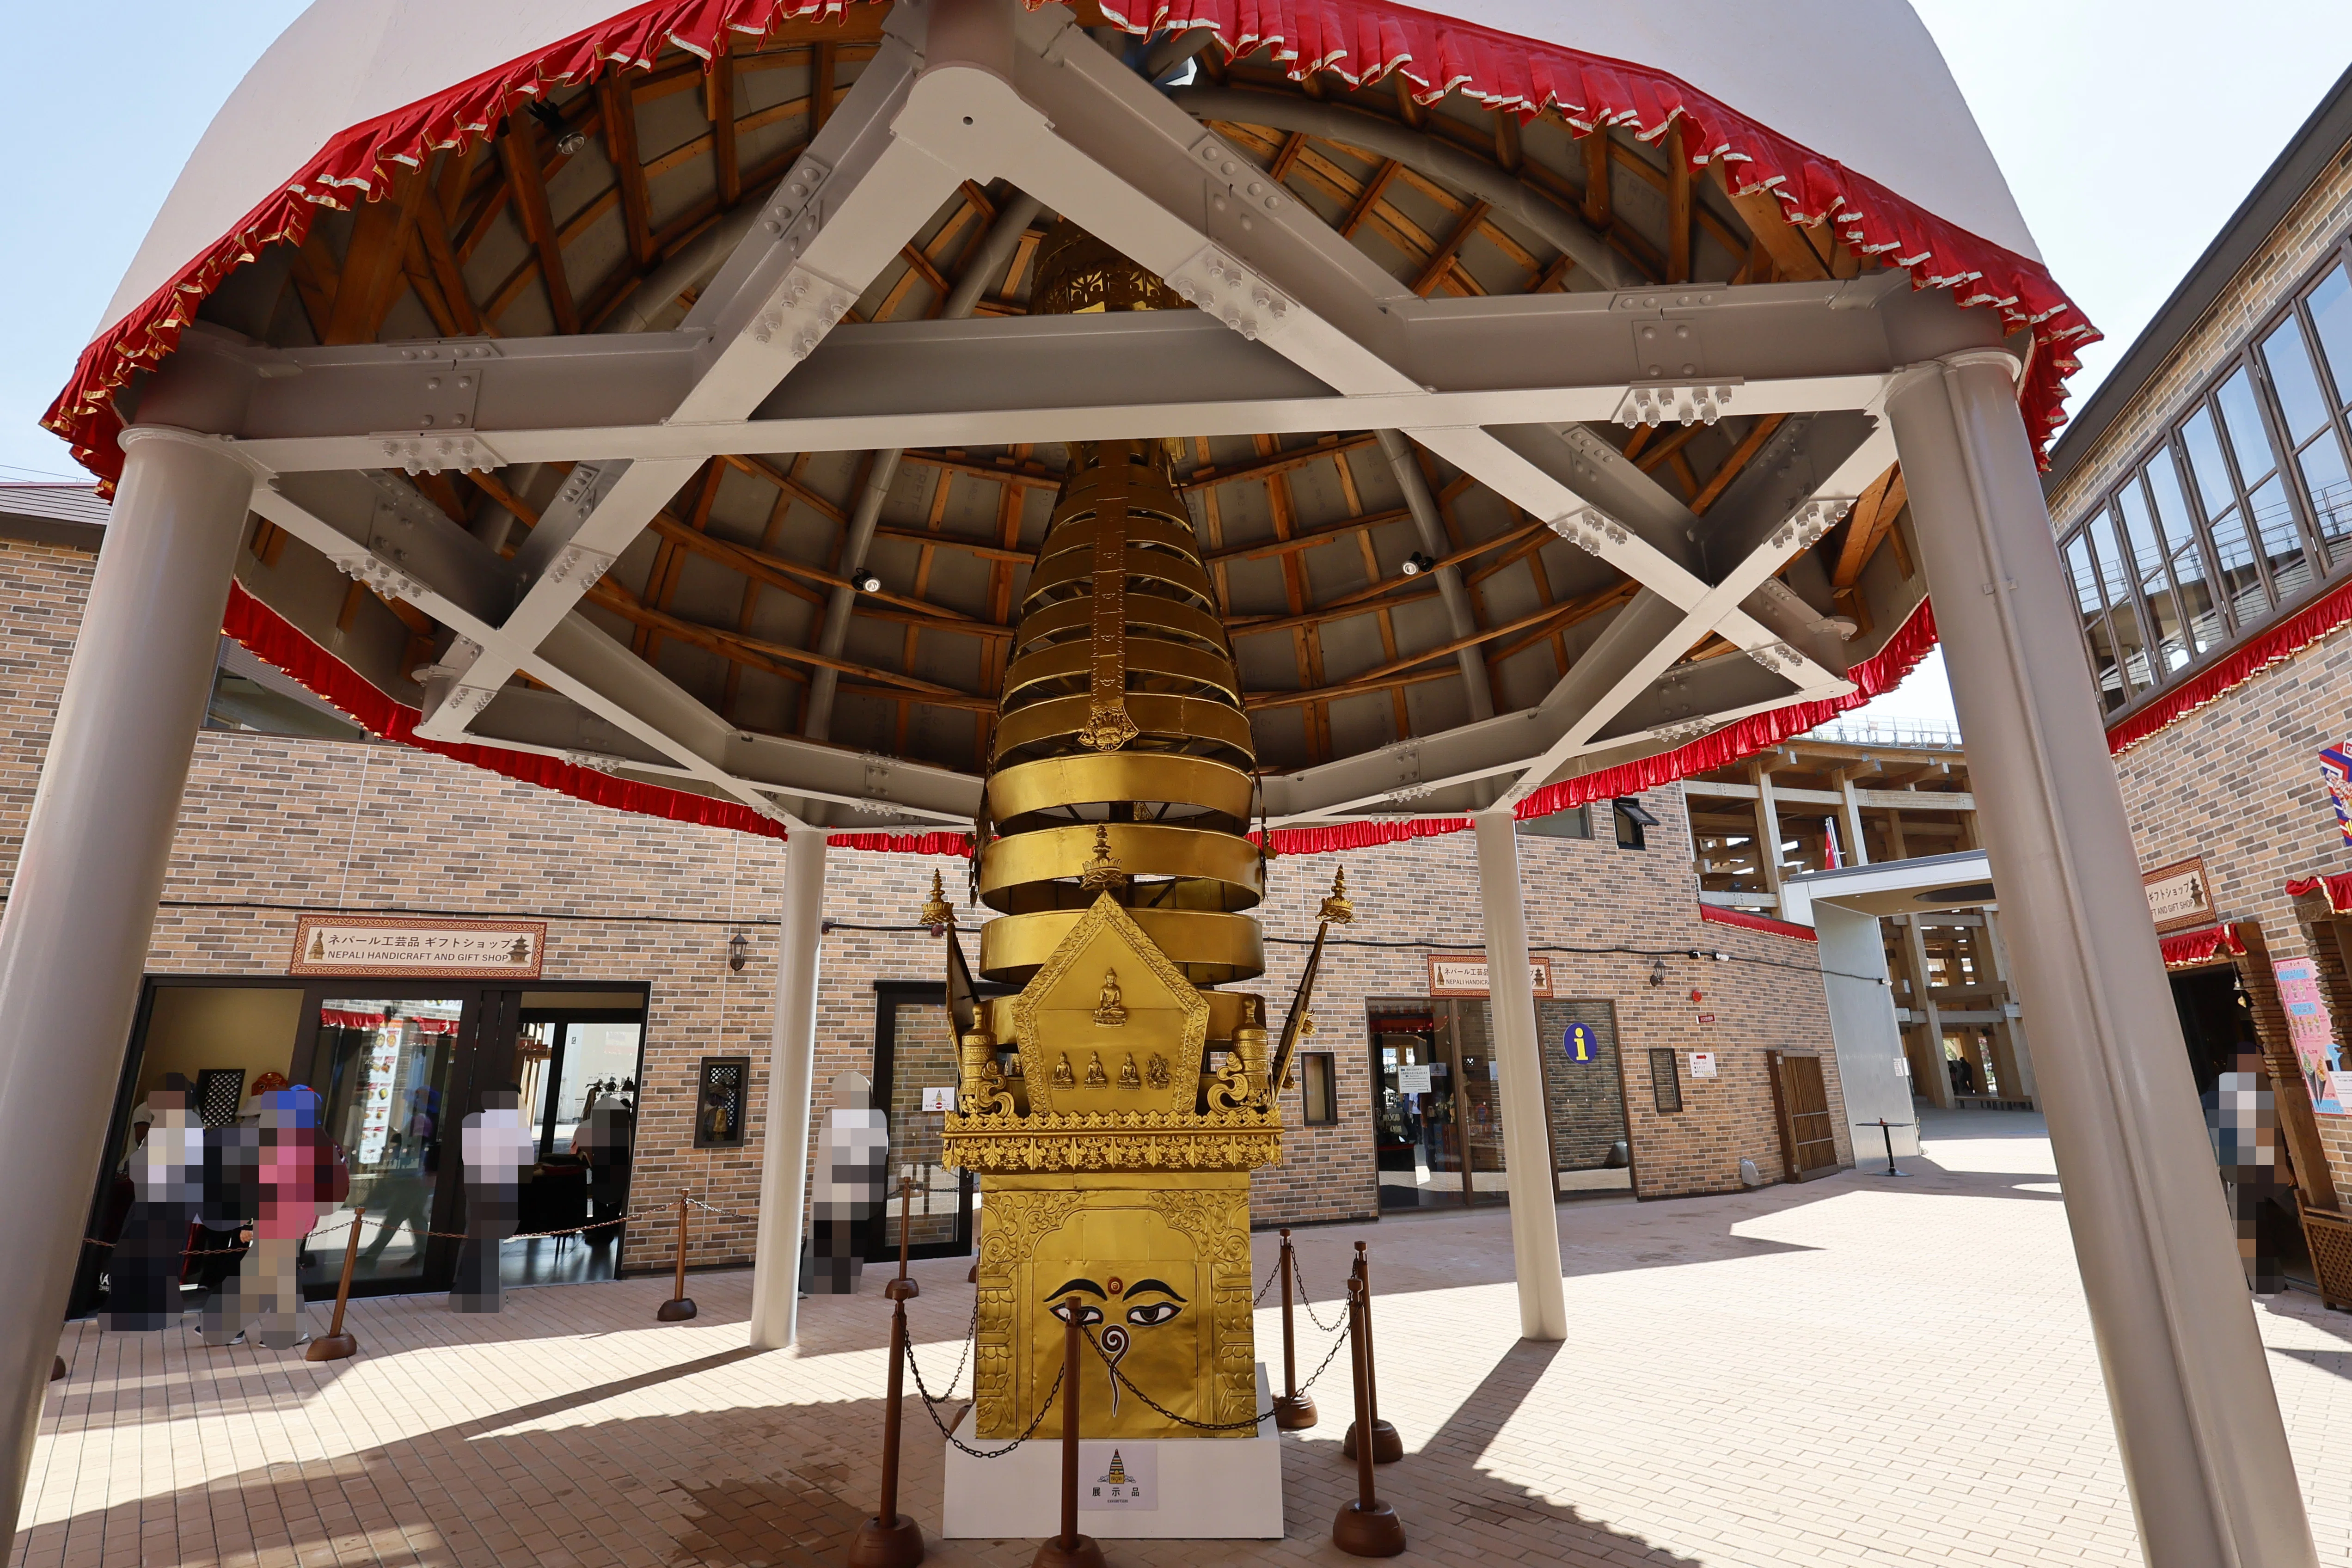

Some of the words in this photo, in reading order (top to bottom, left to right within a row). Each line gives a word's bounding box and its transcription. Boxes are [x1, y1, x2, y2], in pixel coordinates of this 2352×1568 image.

[2149, 880, 2189, 902] ギフトショップ
[2158, 906, 2168, 915] AND
[2168, 903, 2179, 912] GIFT
[2179, 899, 2193, 910] SHOP
[328, 935, 420, 947] ネパール工芸品
[425, 937, 513, 949] ギフトショップ
[368, 952, 432, 960] HANDICRAFT
[1092, 1487, 1139, 1497] 展示品
